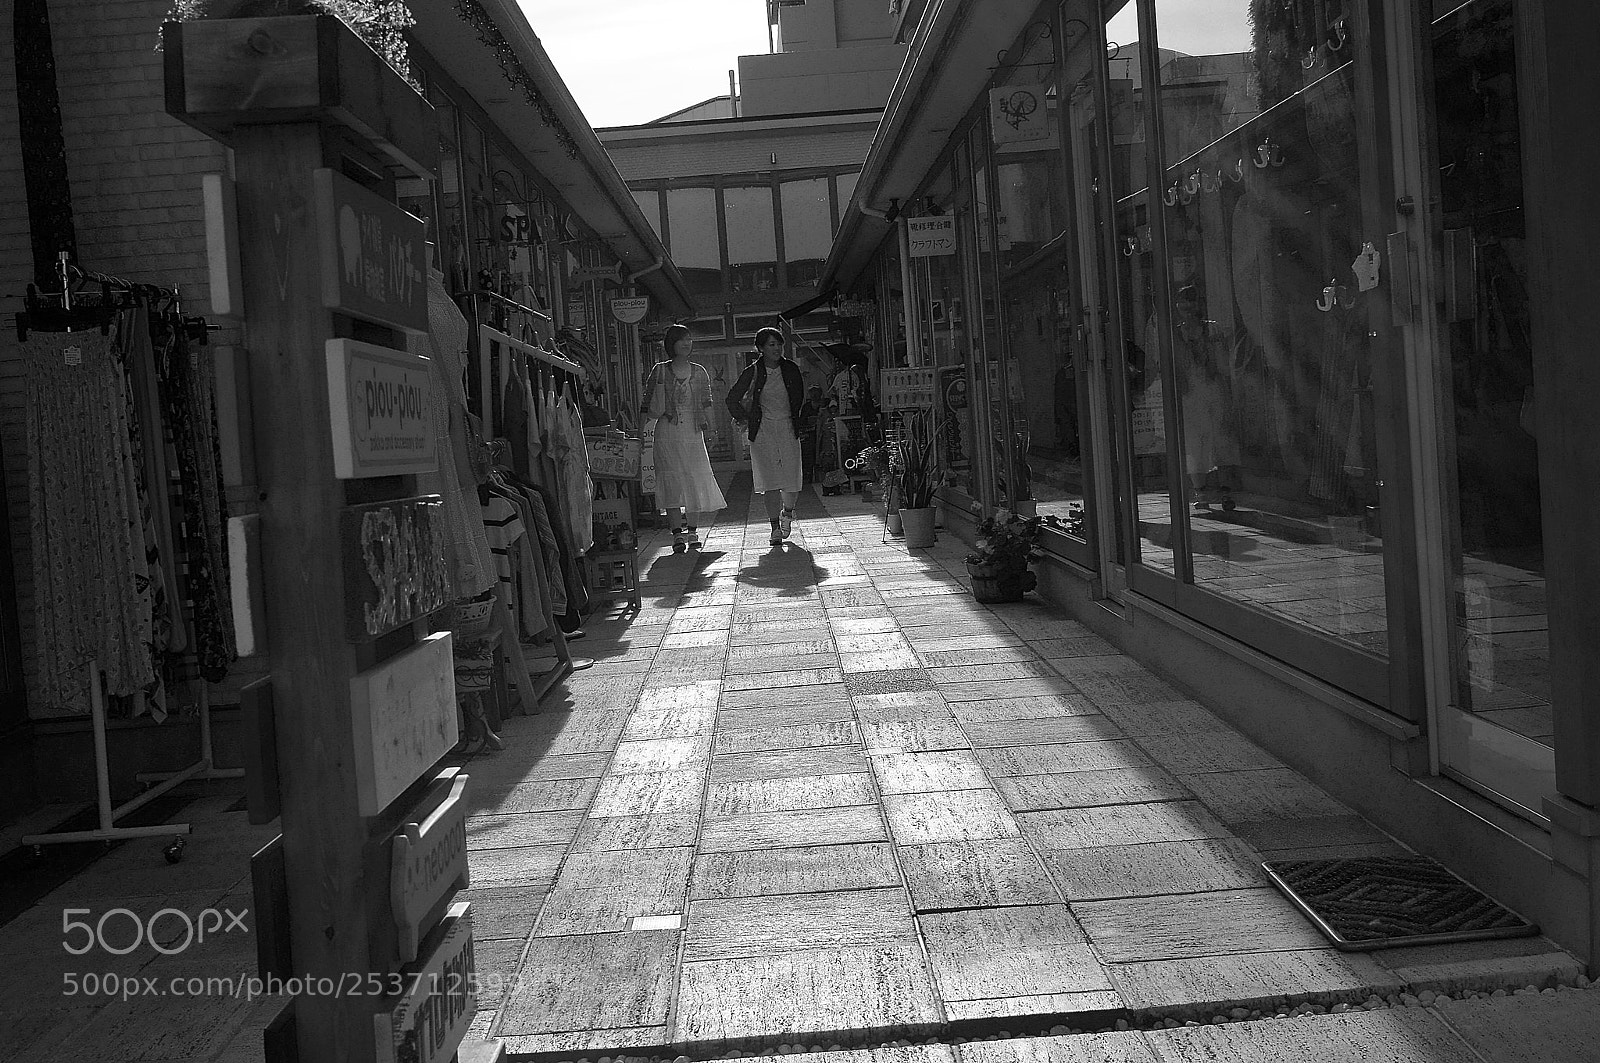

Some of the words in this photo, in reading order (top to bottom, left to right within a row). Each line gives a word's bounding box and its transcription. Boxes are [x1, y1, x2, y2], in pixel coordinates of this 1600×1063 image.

[911, 238, 952, 250] クラフトマン
[614, 299, 646, 308] piou-piou
[365, 367, 422, 430] piou-piou
[592, 456, 638, 475] OPEN
[424, 821, 462, 892] necoco
